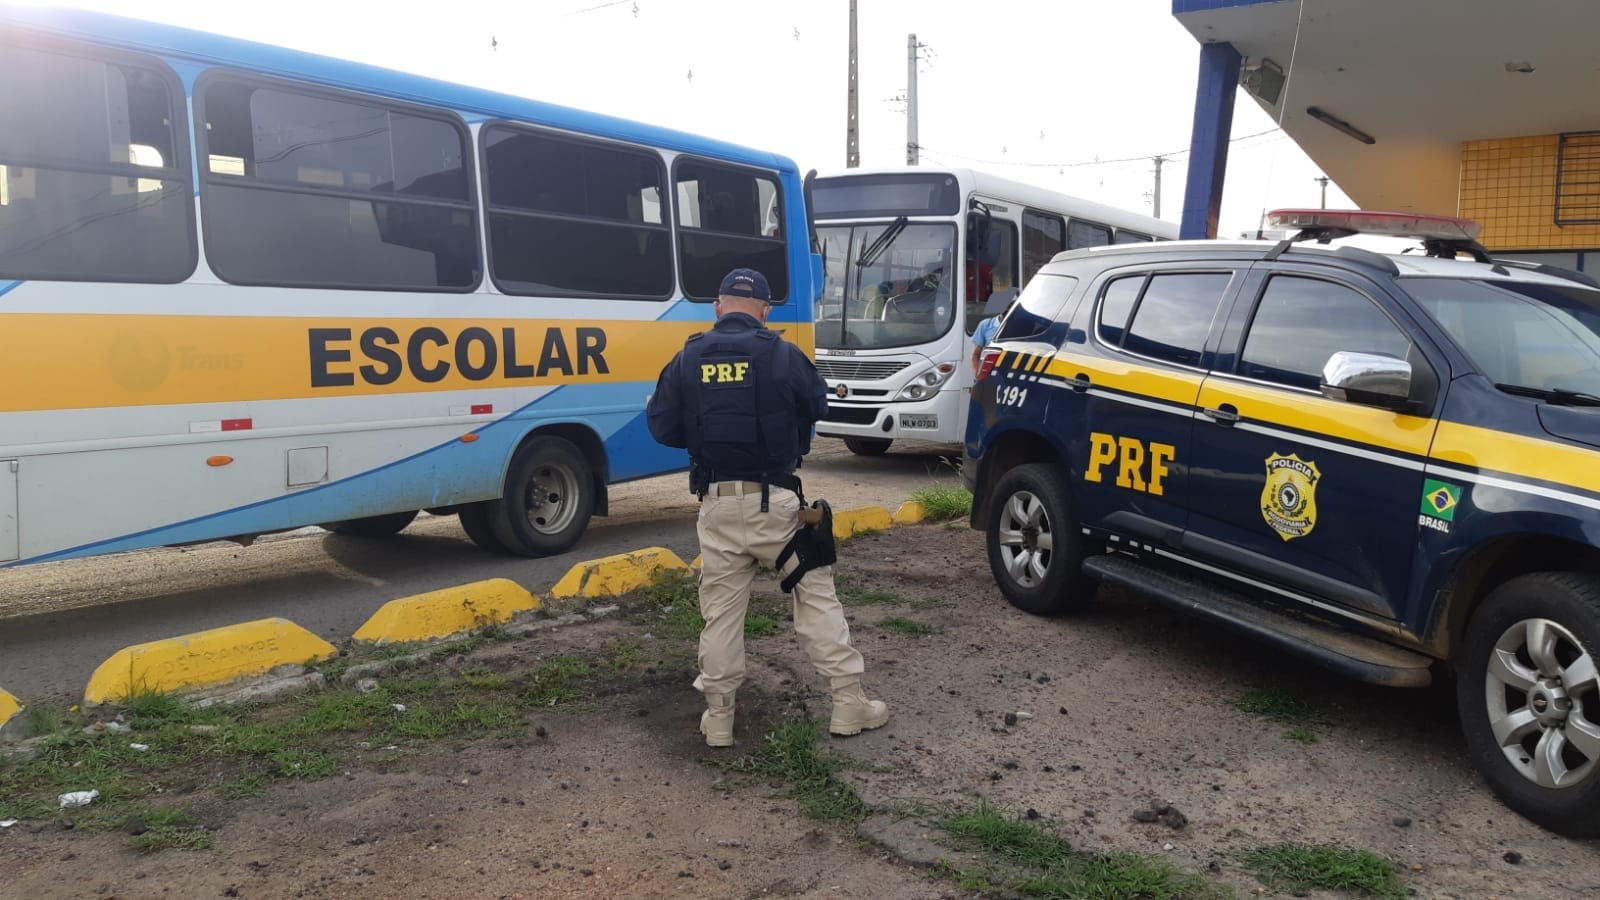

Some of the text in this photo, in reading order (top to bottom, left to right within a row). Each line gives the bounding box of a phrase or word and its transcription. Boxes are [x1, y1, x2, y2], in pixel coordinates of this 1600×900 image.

[308, 327, 610, 388] ESCOLAR
[701, 362, 749, 383] PRF
[1001, 386, 1028, 408] 191
[1084, 432, 1175, 496] PRF
[1419, 515, 1449, 533] BRASIL
